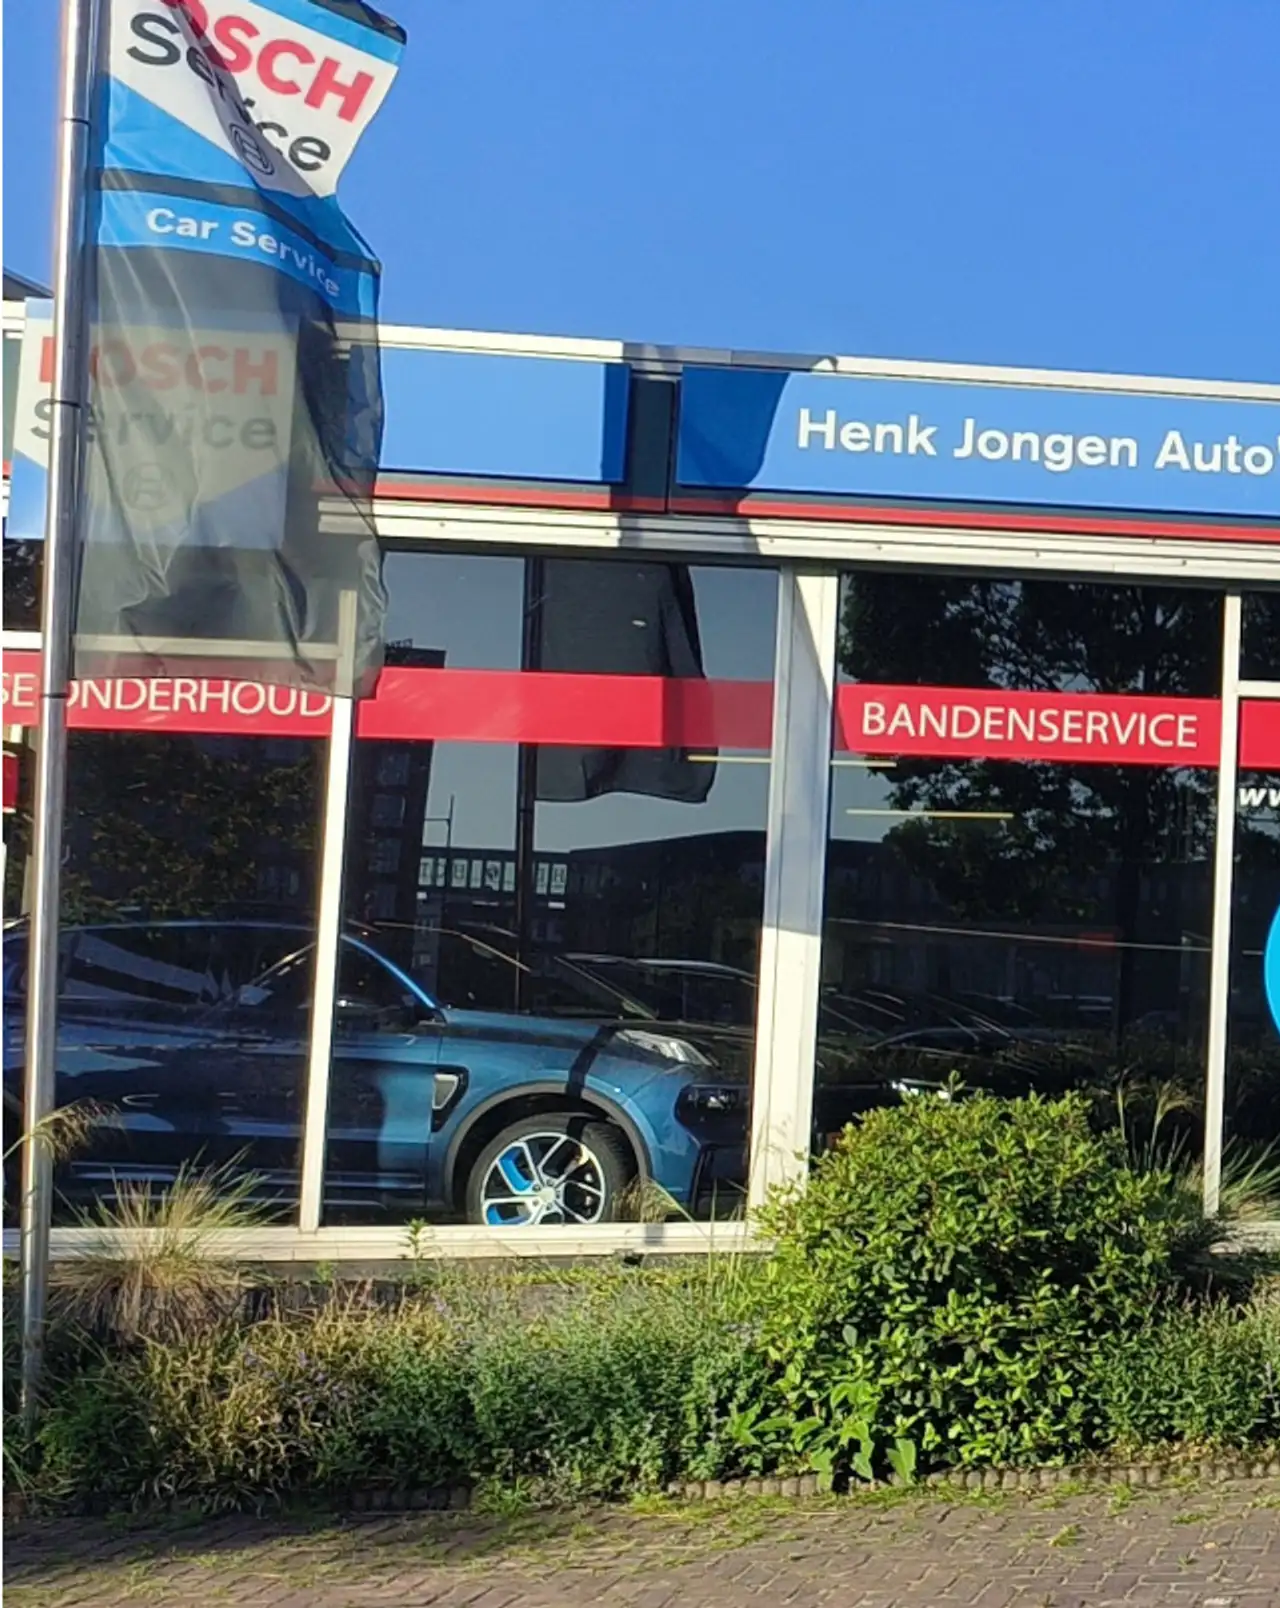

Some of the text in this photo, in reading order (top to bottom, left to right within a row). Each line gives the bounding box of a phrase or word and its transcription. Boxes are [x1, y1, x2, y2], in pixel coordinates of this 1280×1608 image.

[146, 207, 340, 298] Car Service
[39, 336, 279, 396] OSCH
[797, 408, 937, 457] Henk
[953, 418, 1138, 473] Jongen
[862, 701, 1198, 748] BANDENSERVICE
